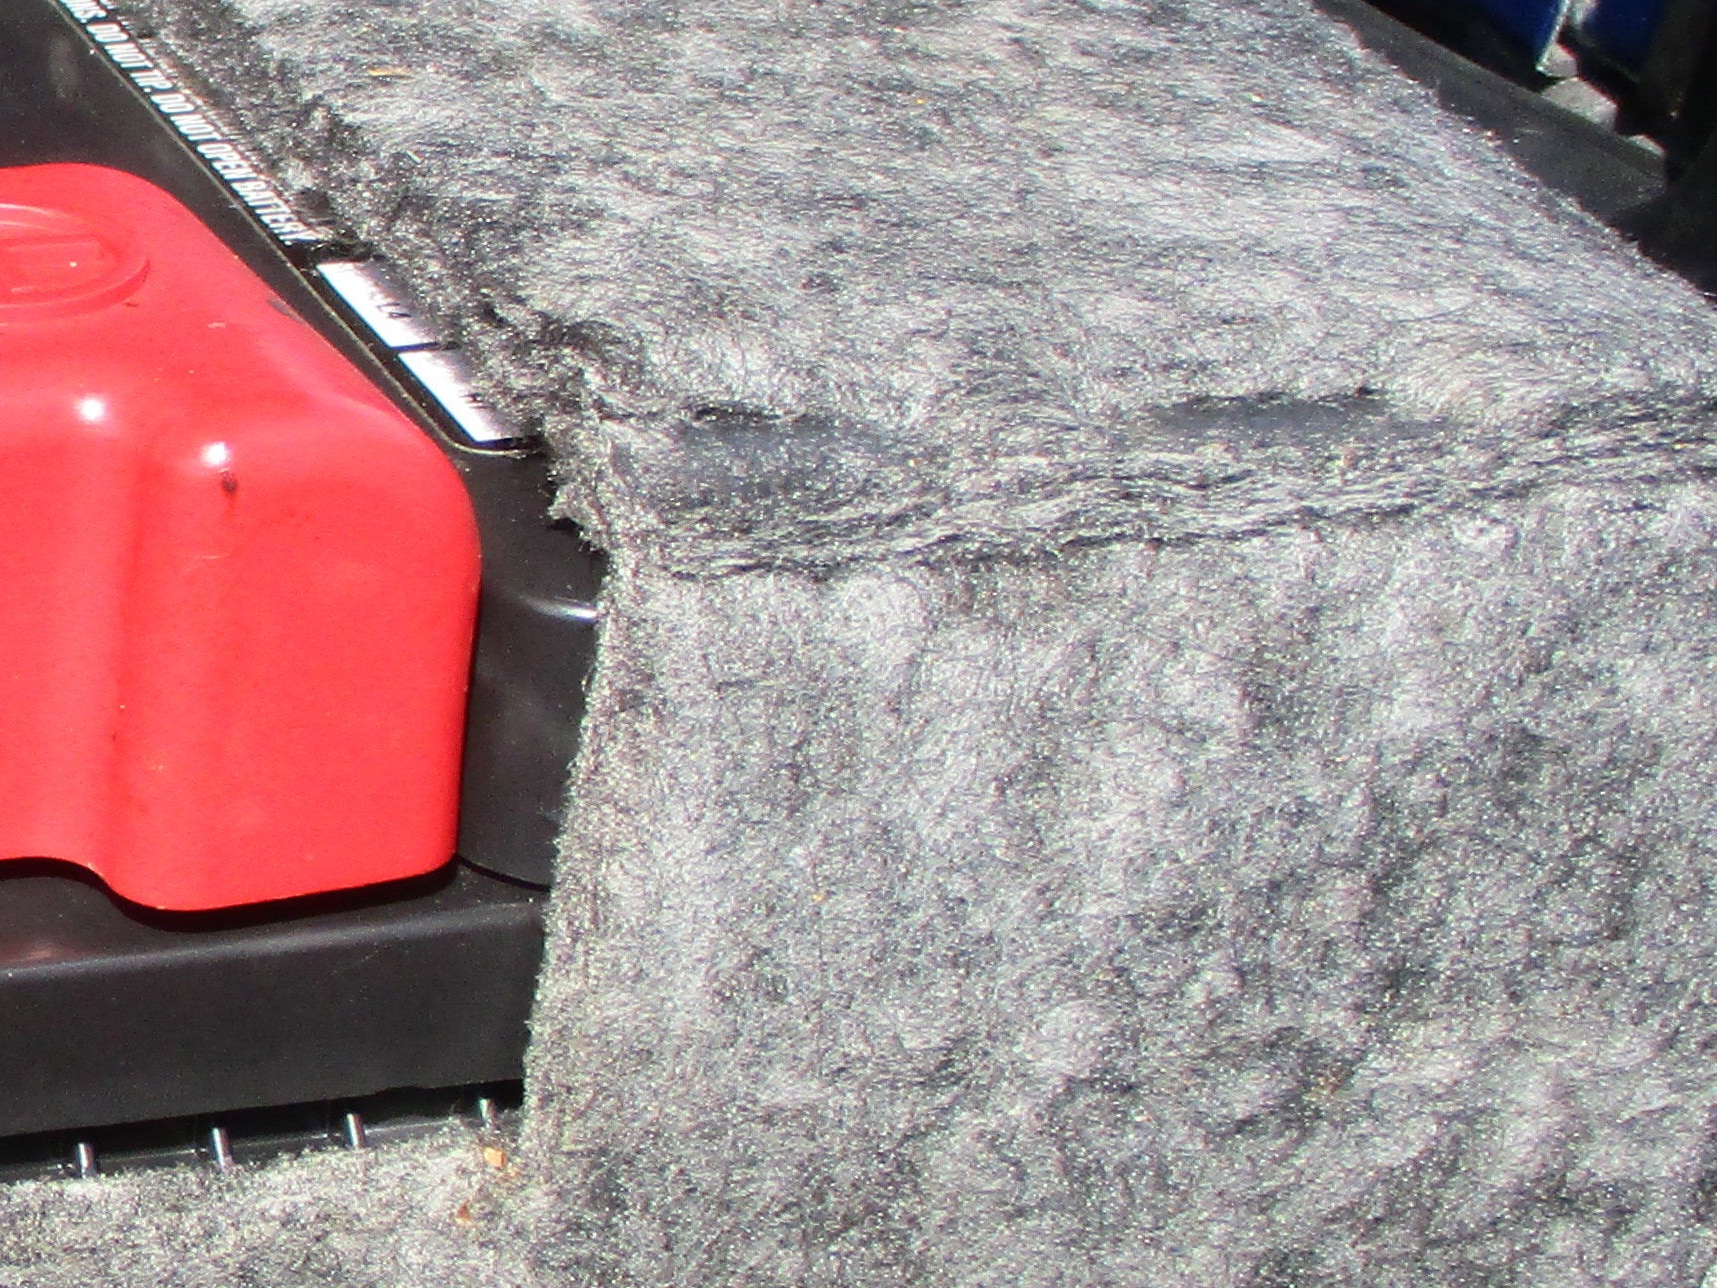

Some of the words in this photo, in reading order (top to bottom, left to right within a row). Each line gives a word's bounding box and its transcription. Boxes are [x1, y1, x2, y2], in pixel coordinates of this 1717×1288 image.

[85, 22, 131, 43] DO
[103, 41, 154, 69] NOT
[150, 92, 196, 113] DO
[169, 112, 223, 142] NOT
[196, 142, 259, 181] OPEN
